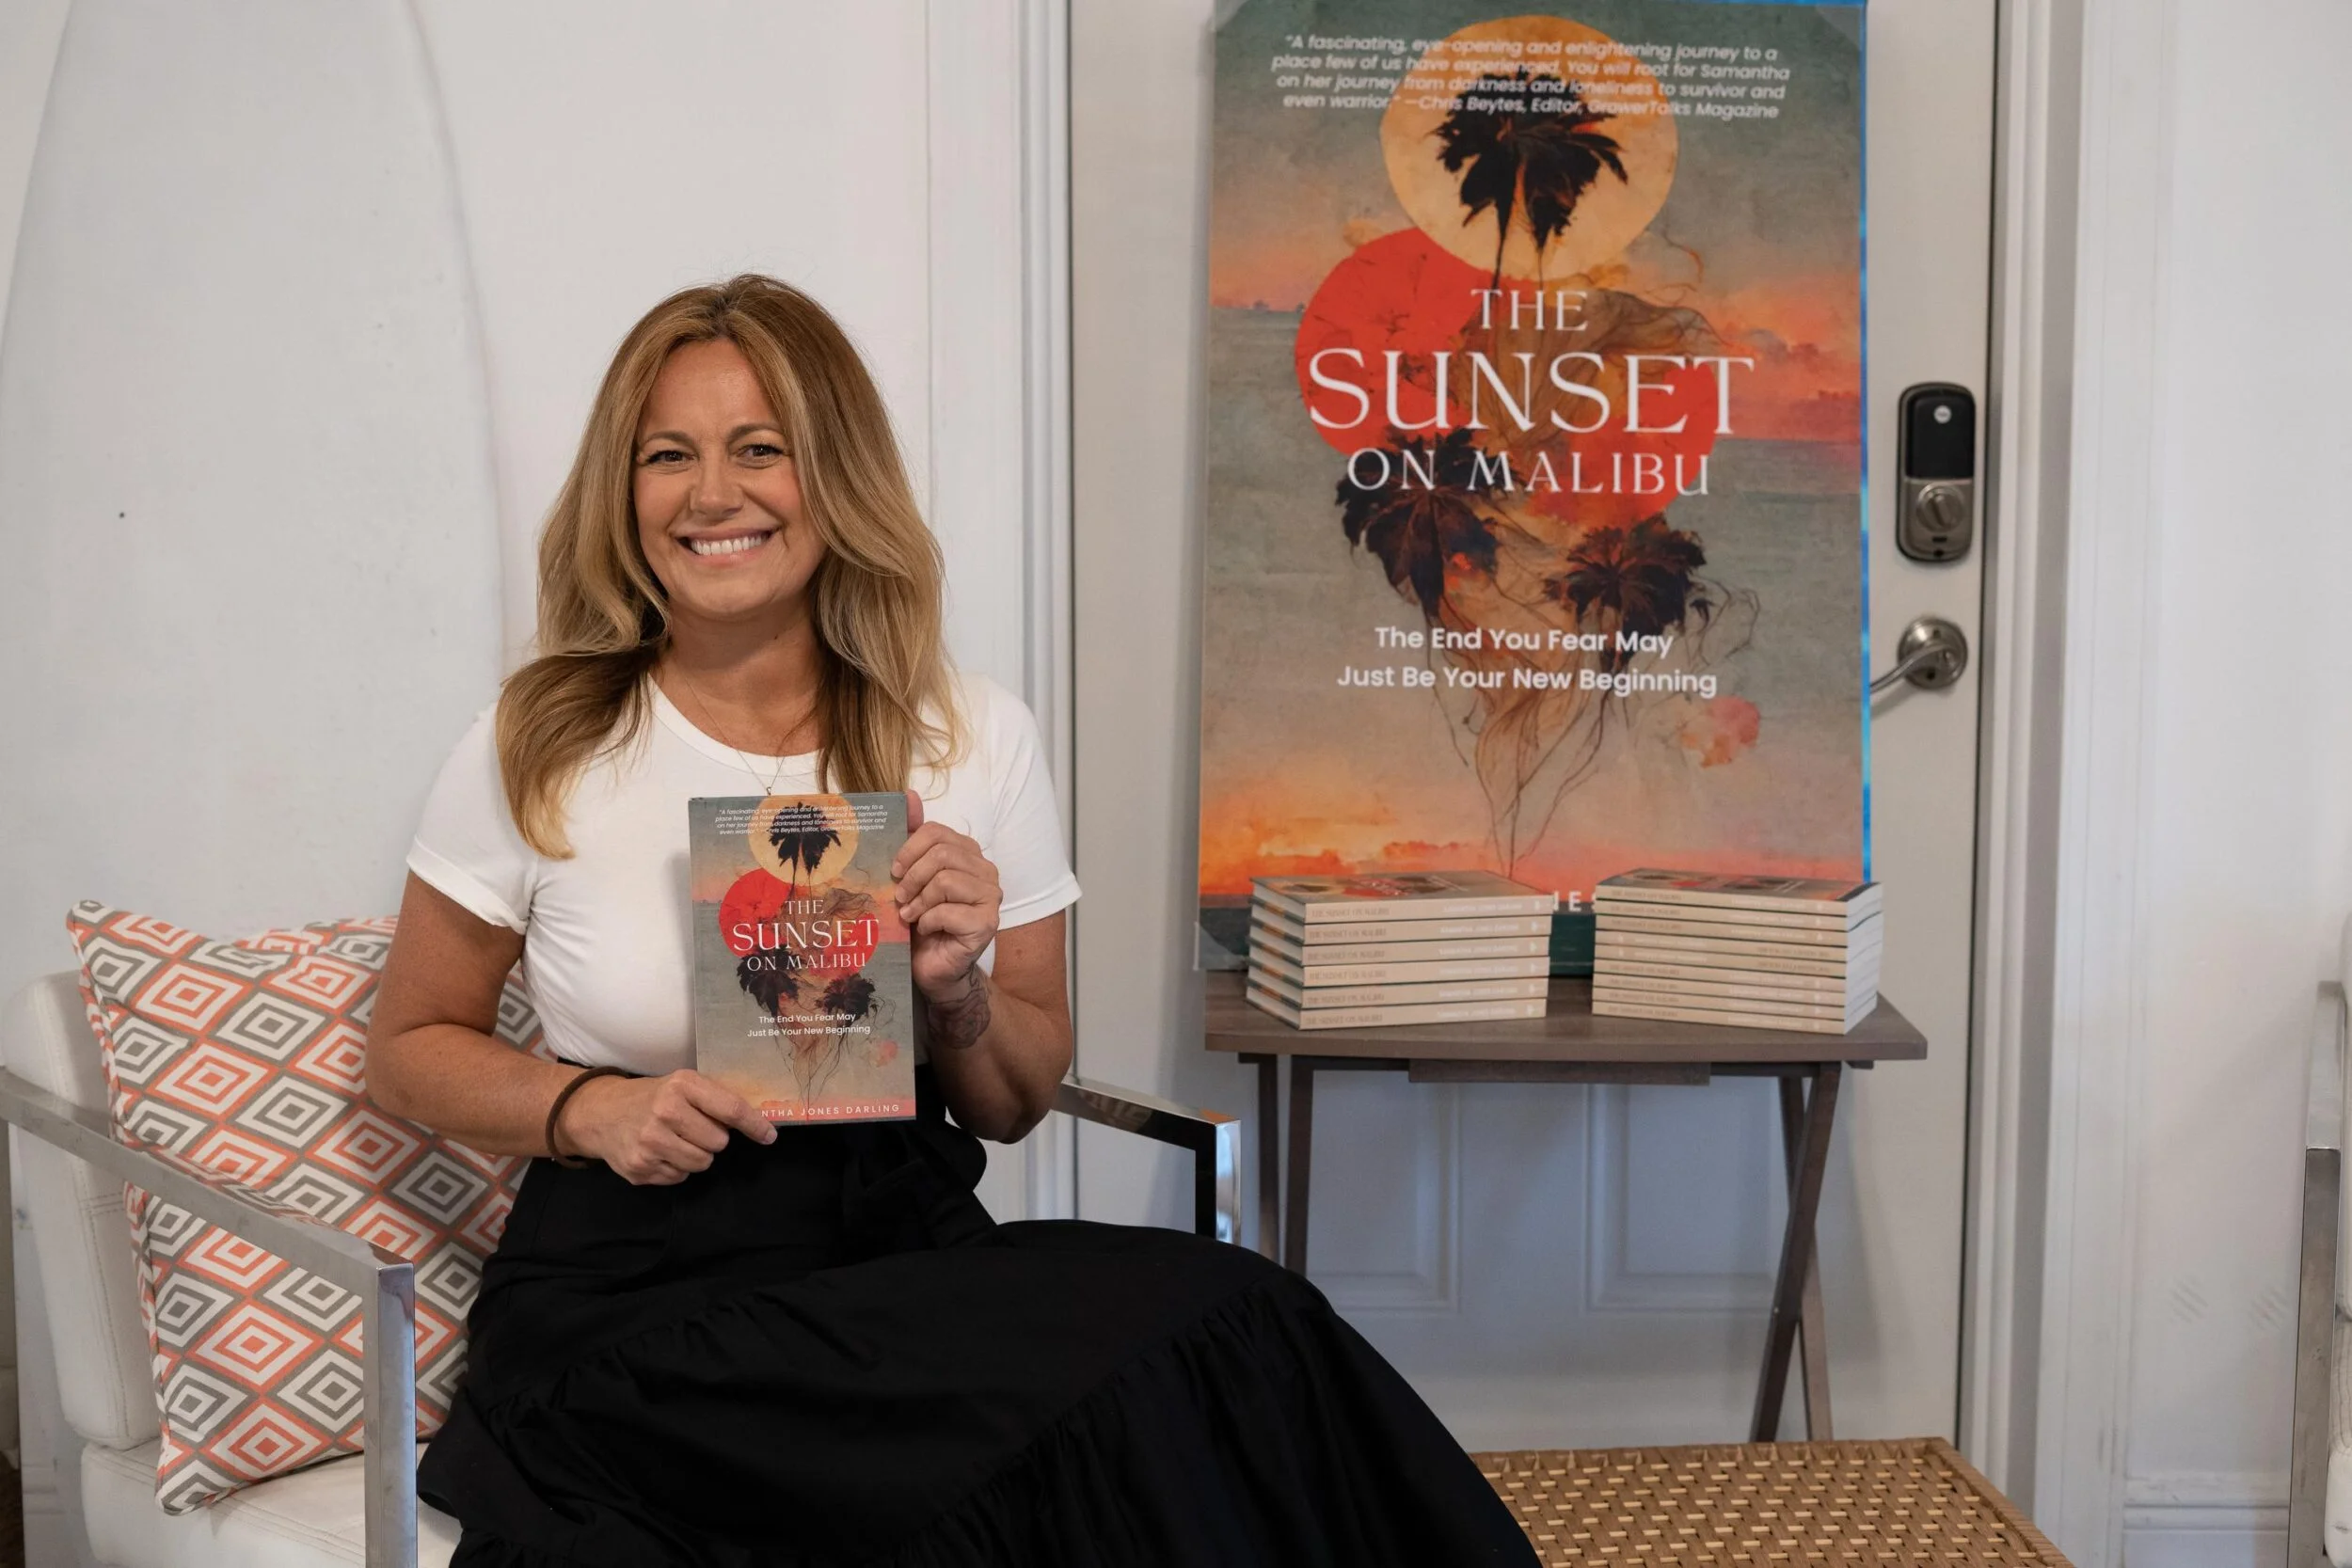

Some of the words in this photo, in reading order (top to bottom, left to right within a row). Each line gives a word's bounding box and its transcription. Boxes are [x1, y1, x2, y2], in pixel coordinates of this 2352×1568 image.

[1308, 35, 1407, 55] fascinating,
[1411, 40, 1523, 57] eye-opening
[1526, 41, 1562, 55] and
[1565, 41, 1672, 61] enlightening
[1674, 43, 1740, 62] journey
[1743, 46, 1761, 60] to
[1765, 49, 1778, 61] a
[1271, 55, 1322, 71] place
[1325, 55, 1356, 69] few
[1359, 56, 1378, 70] of
[1382, 58, 1402, 71] us
[1406, 57, 1450, 71] have
[1567, 61, 1597, 75] You
[1603, 61, 1630, 75] will
[1633, 63, 1668, 76] root
[1673, 63, 1697, 77] for
[1700, 65, 1791, 81] Samantha
[1277, 76, 1299, 88] on
[1303, 74, 1332, 88] her
[1334, 74, 1400, 92] journey
[1404, 76, 1444, 90] from
[1448, 76, 1526, 92] darkness
[1531, 79, 1565, 93] and
[1569, 79, 1653, 96] loneliness
[1658, 83, 1676, 97] to
[1679, 84, 1747, 98] survivor
[1751, 85, 1786, 100] and
[1283, 95, 1325, 107] even
[1467, 97, 1527, 116] Beytes,
[1531, 98, 1582, 114] Editor,
[1586, 99, 1691, 117] GrowerTalks
[1694, 102, 1779, 120] Magazine
[1471, 289, 1589, 332] THE
[1309, 347, 1755, 436] SUNSET
[1347, 447, 1435, 492] ON
[1467, 447, 1711, 496] MALIBU
[1375, 626, 1424, 650] The
[1431, 626, 1482, 651] End
[1488, 628, 1541, 652] You
[1548, 628, 1608, 653] Fear
[1614, 630, 1674, 659] May
[1337, 665, 1394, 688] Just
[1402, 666, 1436, 689] Be
[1441, 667, 1506, 690] Your
[1513, 669, 1571, 691] New
[1580, 669, 1718, 699] Beginning
[785, 899, 824, 915] THE
[733, 918, 880, 951] SUNSET
[747, 956, 776, 972] ON
[787, 952, 866, 970] MALIBU
[747, 1029, 767, 1037] Just
[768, 1028, 780, 1037] Be
[781, 1027, 802, 1036] Your
[803, 1026, 824, 1035] New
[825, 1024, 871, 1035] Beginning
[758, 1016, 775, 1024] The
[777, 1015, 794, 1023] End
[795, 1014, 814, 1022] You
[815, 1013, 835, 1022] Fear
[836, 1013, 856, 1023] May
[761, 1108, 794, 1117] NTHA
[802, 1106, 839, 1116] JONES
[846, 1104, 900, 1114] DARLING
